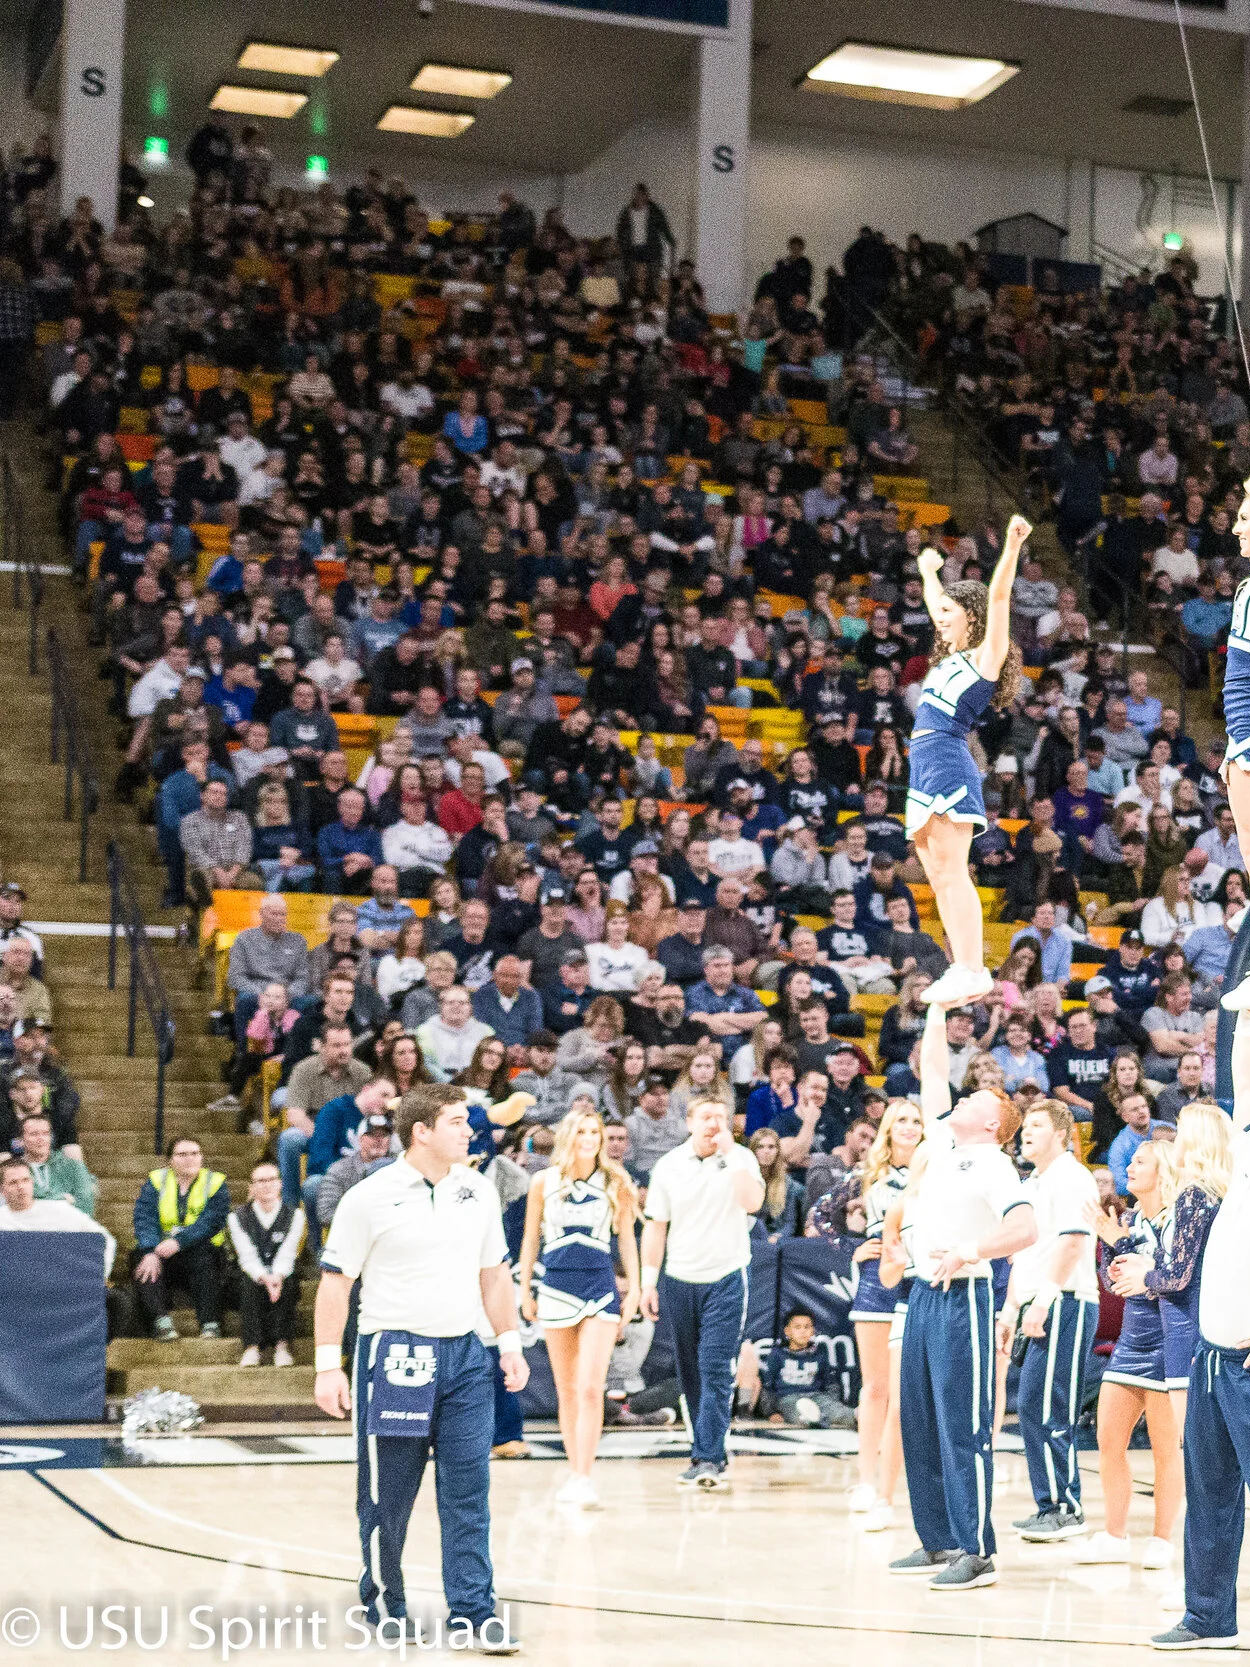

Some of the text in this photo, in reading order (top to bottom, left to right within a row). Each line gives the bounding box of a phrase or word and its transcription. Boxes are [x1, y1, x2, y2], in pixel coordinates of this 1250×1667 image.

[81, 67, 105, 97] S
[712, 145, 734, 173] S
[383, 1357, 437, 1372] STATE
